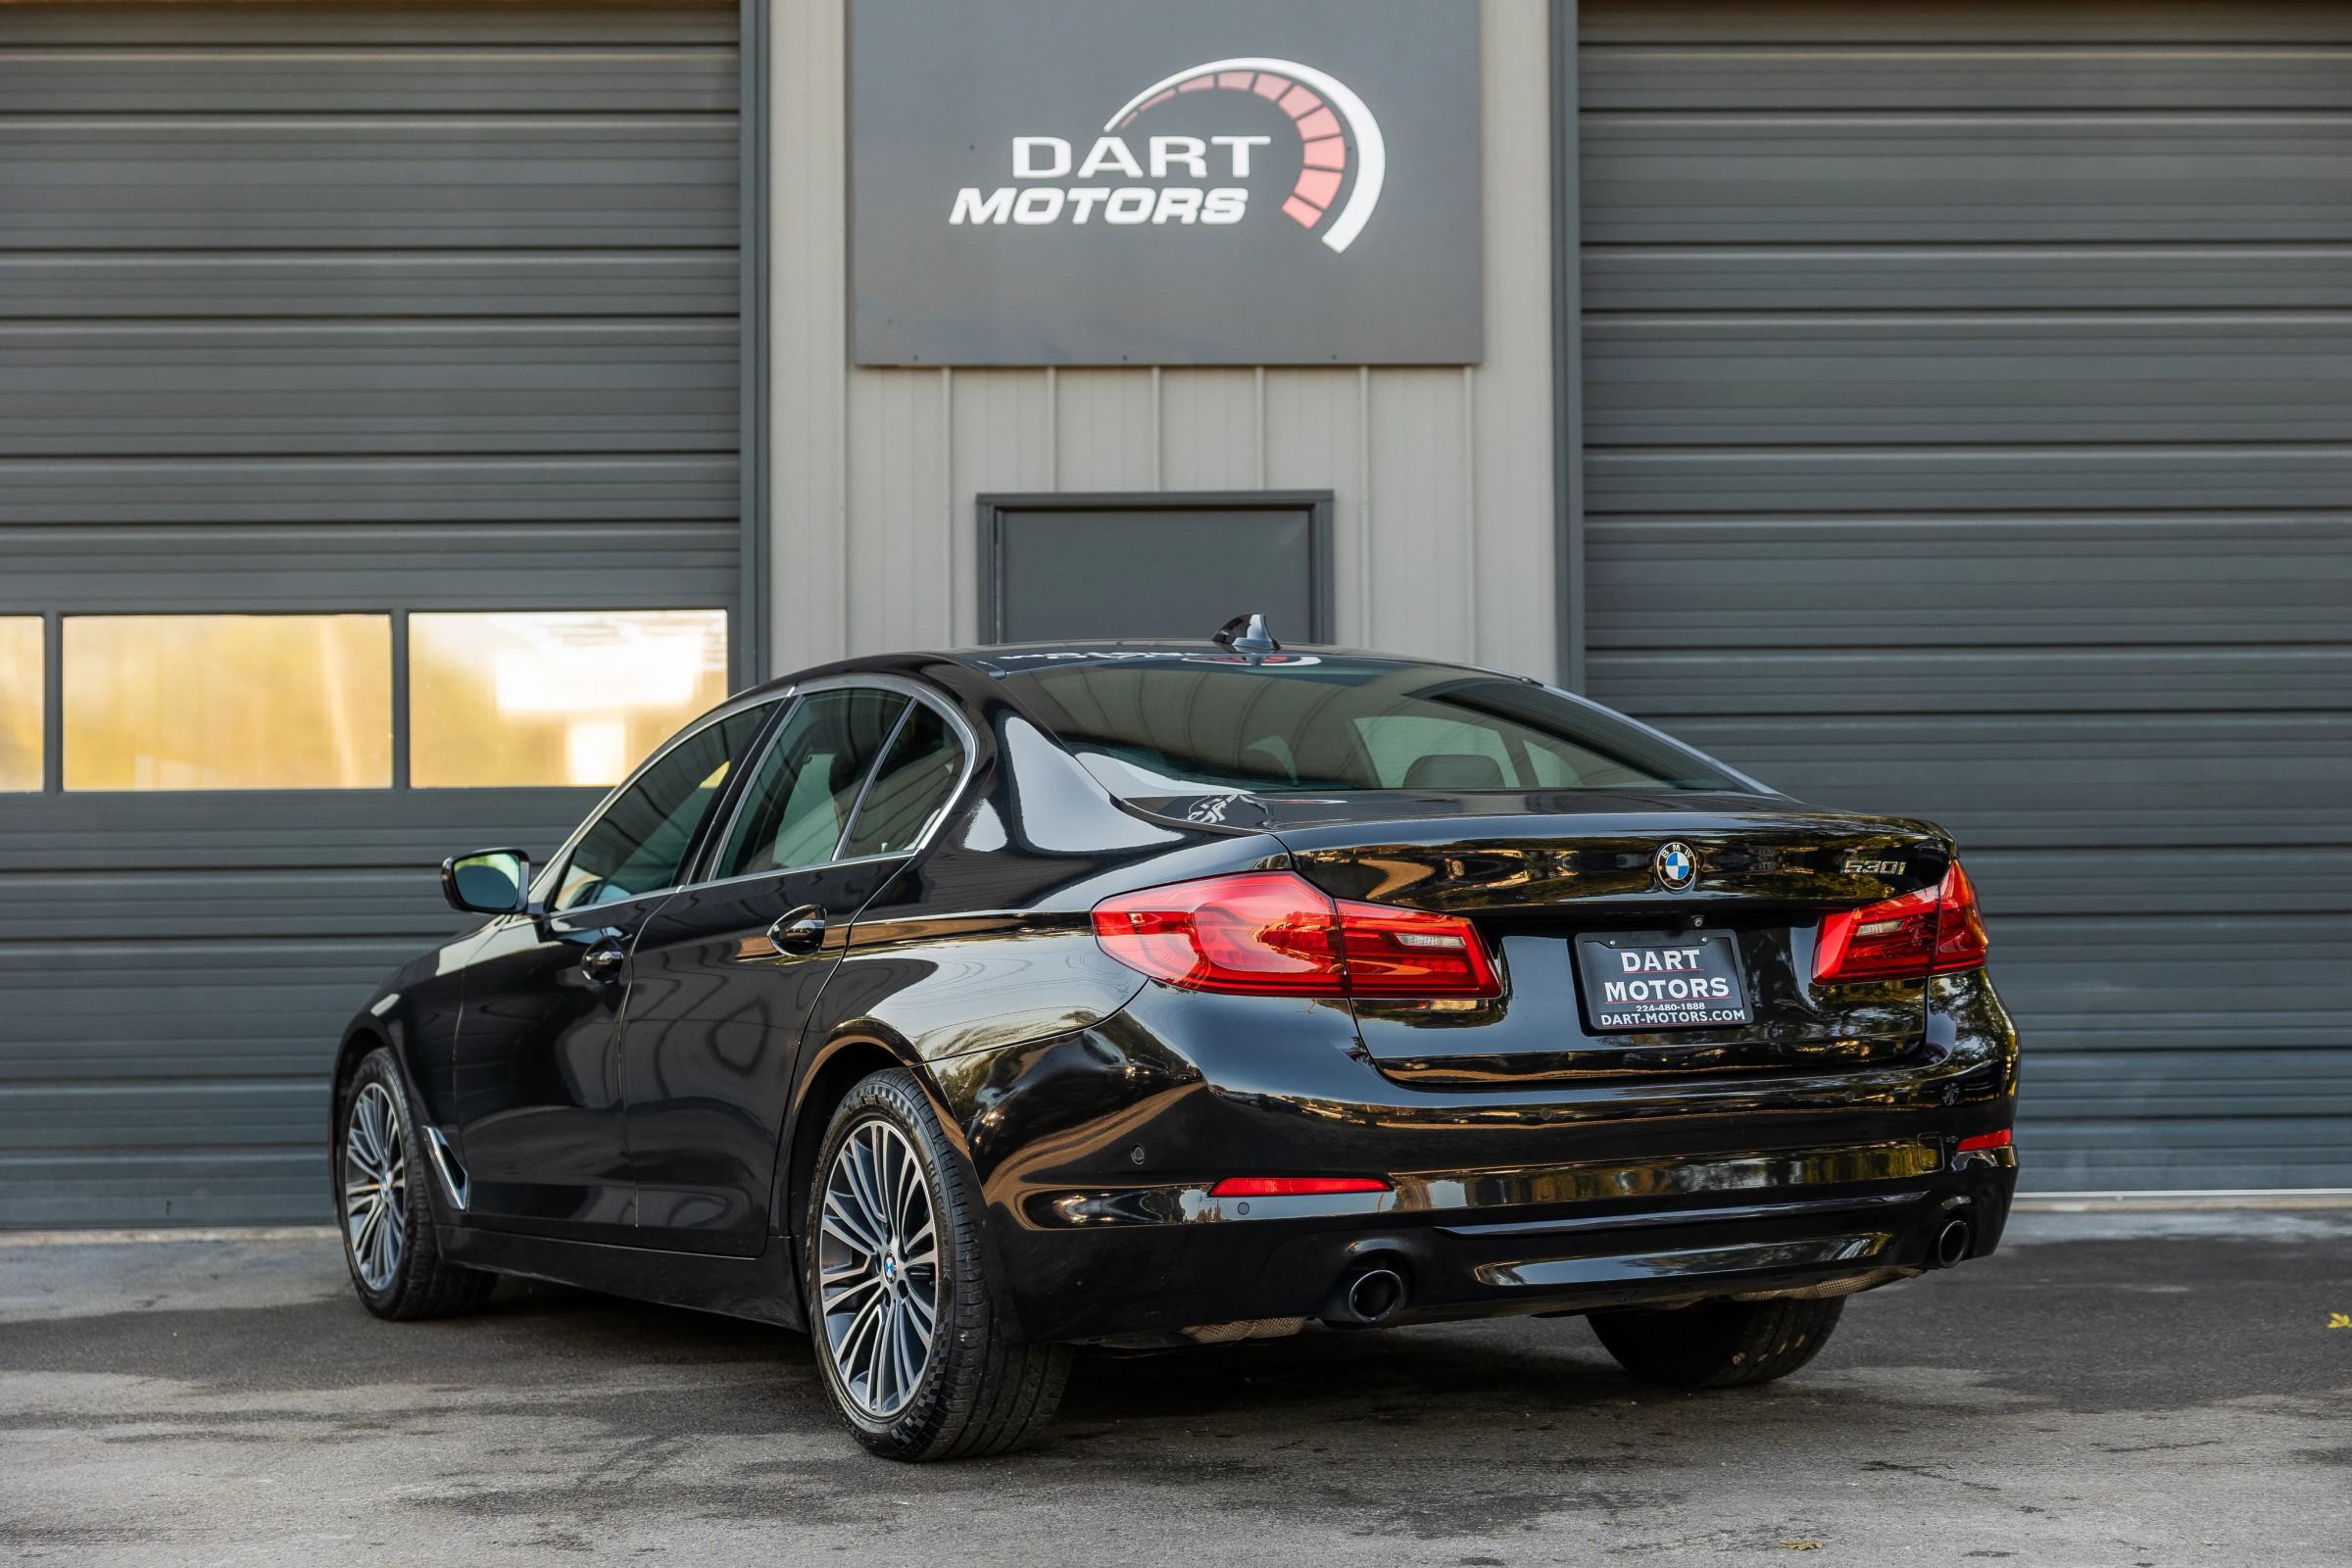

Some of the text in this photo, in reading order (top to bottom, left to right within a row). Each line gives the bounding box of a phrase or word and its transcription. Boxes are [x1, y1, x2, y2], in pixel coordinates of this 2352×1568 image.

[1012, 135, 1271, 178] DART
[949, 187, 1250, 225] MOTORS
[1661, 844, 1693, 859] BMW
[1843, 860, 1907, 875] 530i
[1620, 949, 1700, 972] DART
[1604, 977, 1730, 1002] MOTORS
[1600, 1009, 1745, 1026] DART-MOTORS.COM
[1636, 1003, 1705, 1012] 224-480-1888
